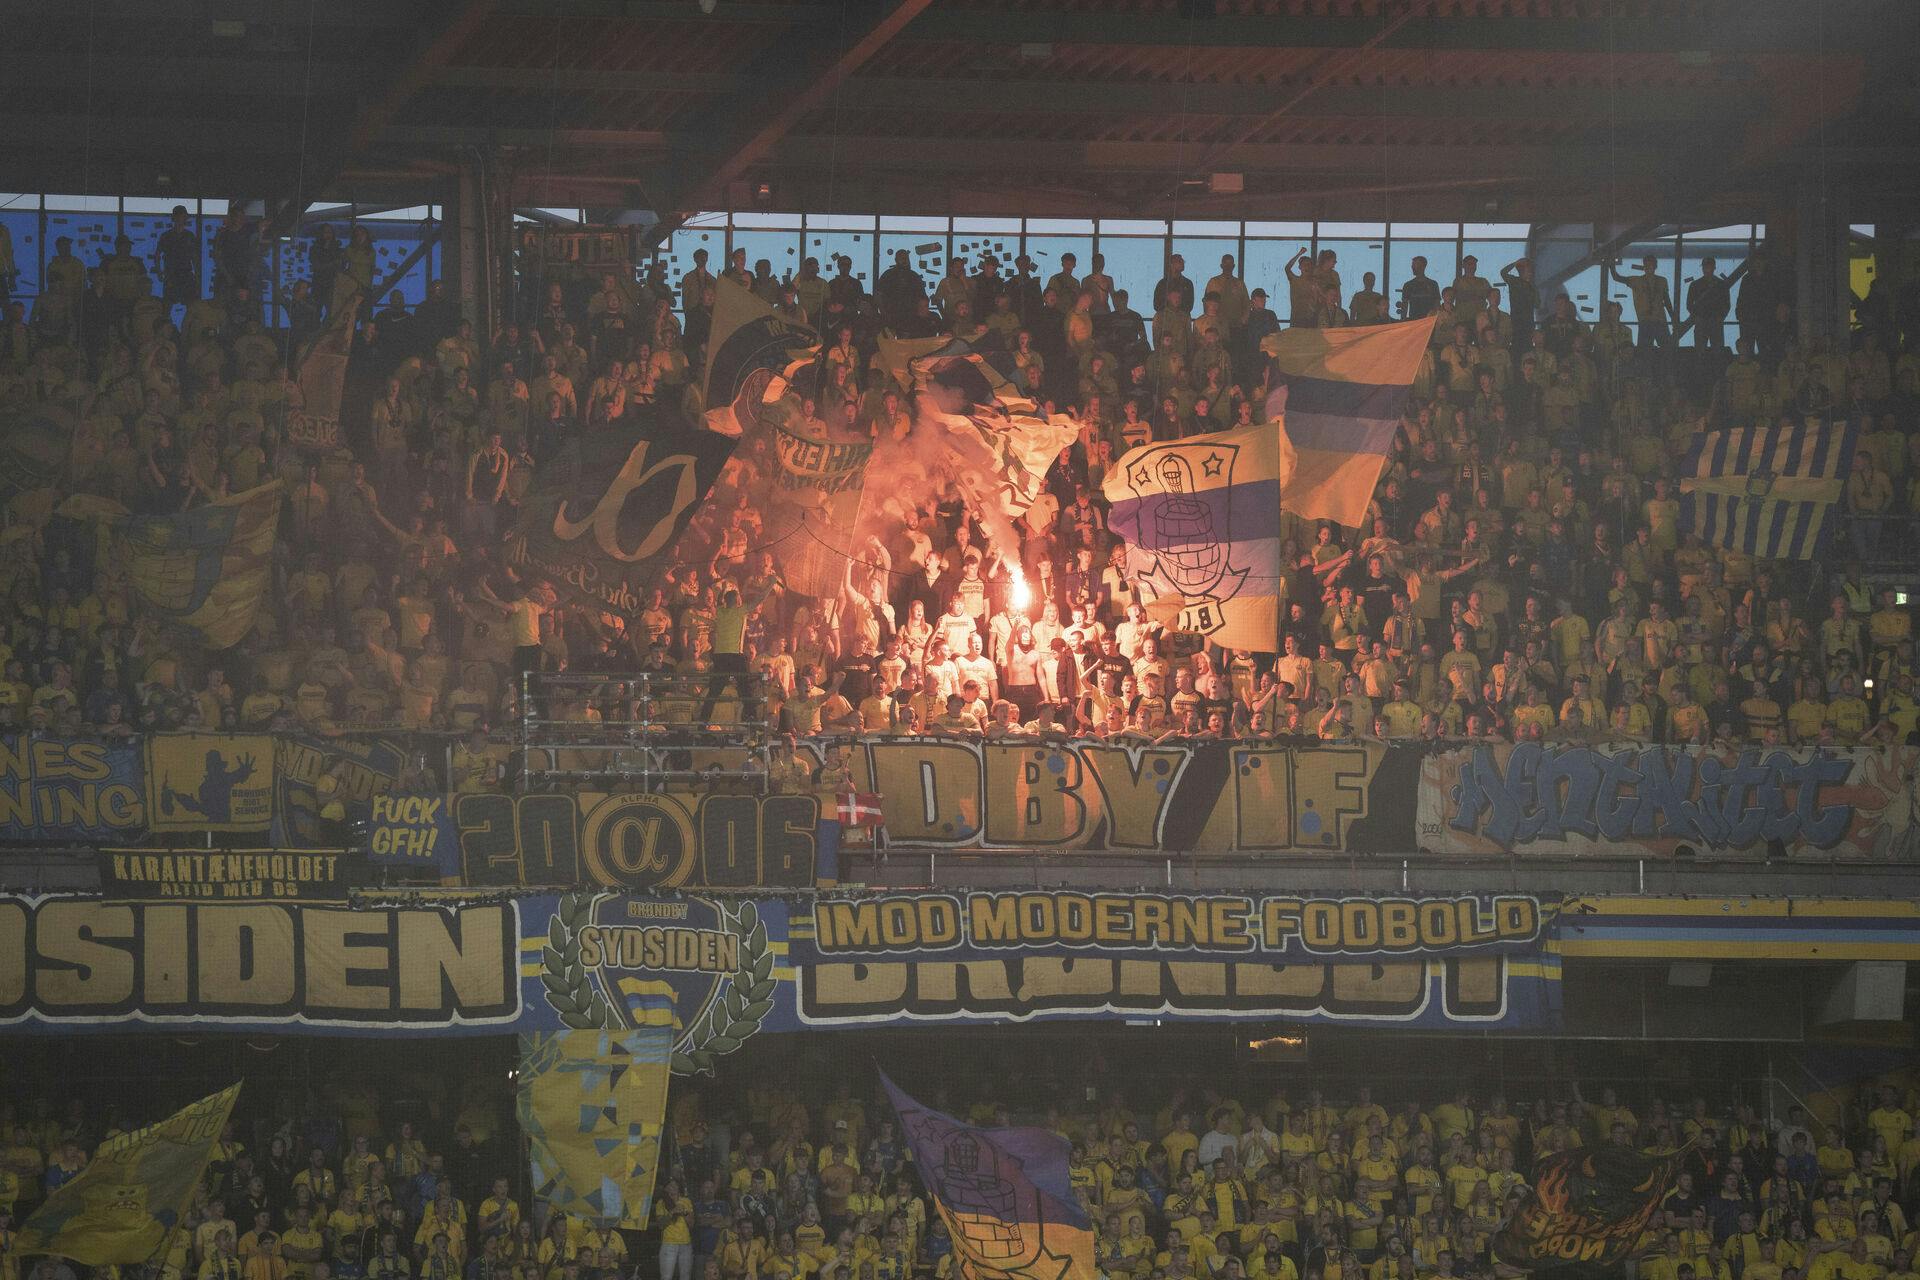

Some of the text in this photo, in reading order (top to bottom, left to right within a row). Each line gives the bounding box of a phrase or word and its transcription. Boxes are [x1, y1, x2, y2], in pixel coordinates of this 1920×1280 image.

[371, 795, 440, 825] FUCK
[620, 795, 660, 806] ALPHA
[1233, 742, 1367, 850] IF
[371, 827, 439, 858] GFH!
[113, 854, 336, 882] KARANTÆNEHOLDET
[160, 880, 299, 897] ALTID MED OS
[817, 897, 1536, 949] IMOD MODERNE FODBOLD
[0, 901, 505, 1010] SIDEN
[580, 927, 739, 972] SYDSIDEN
